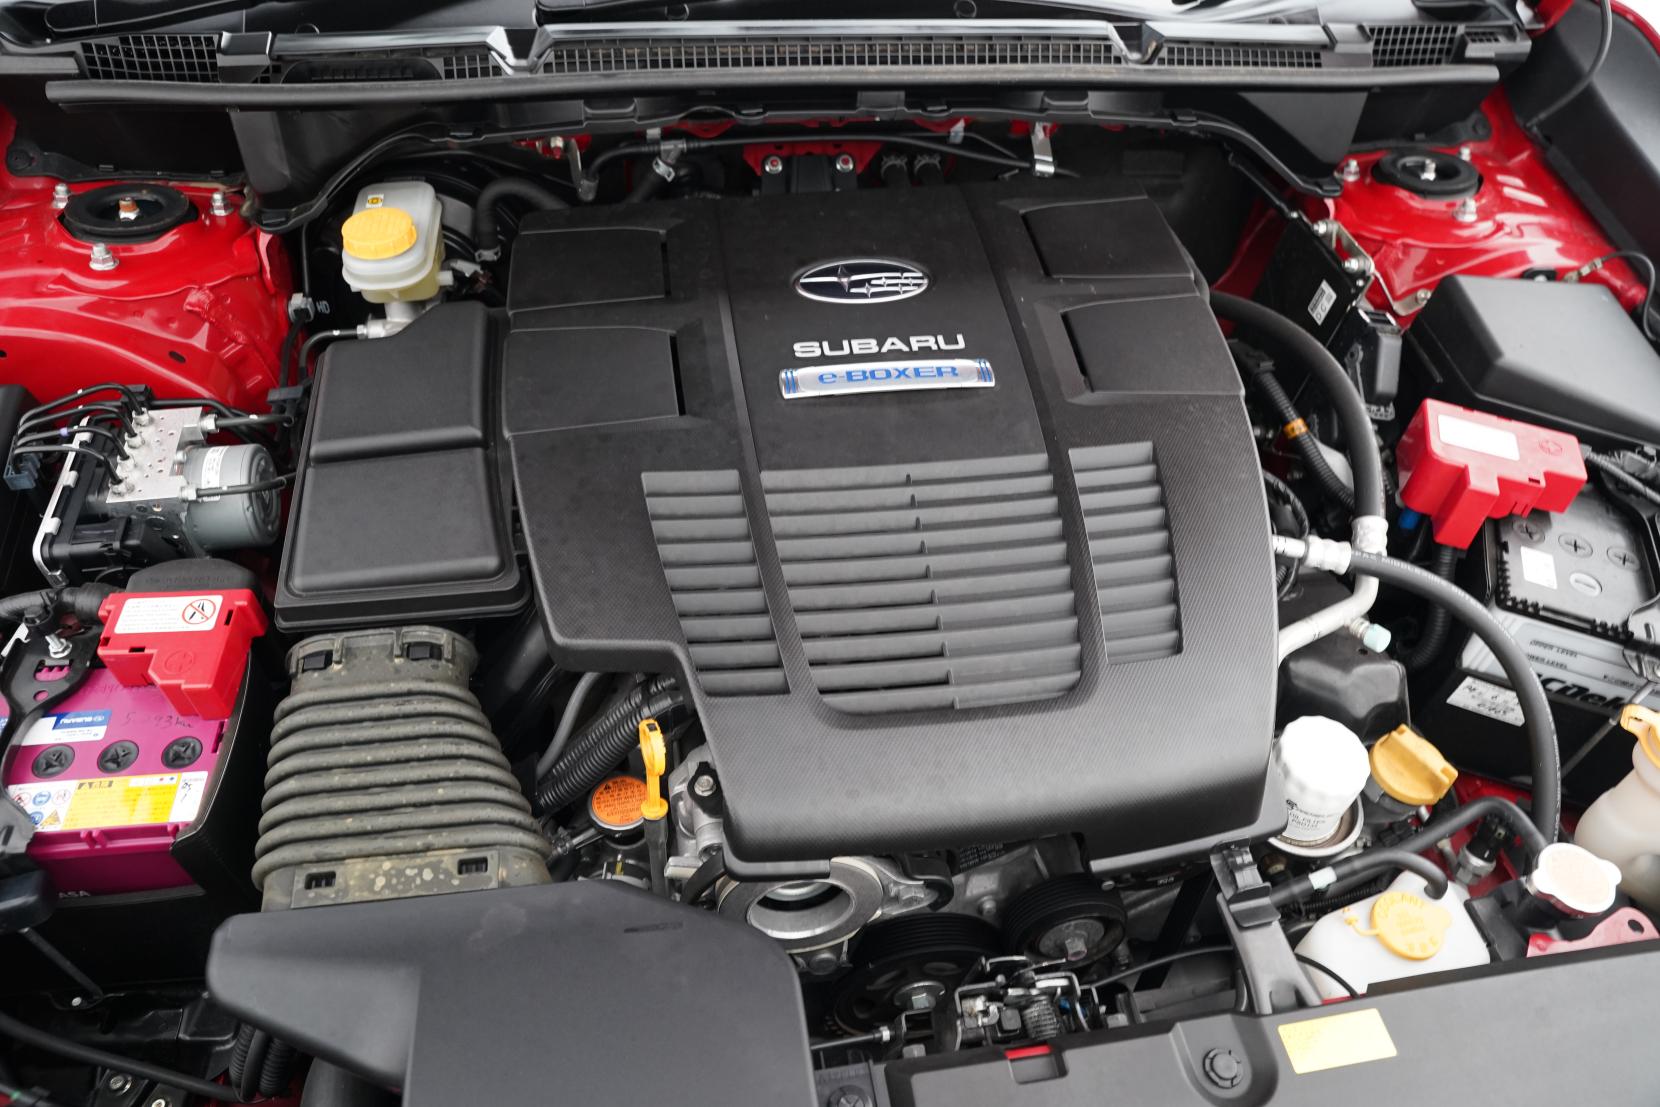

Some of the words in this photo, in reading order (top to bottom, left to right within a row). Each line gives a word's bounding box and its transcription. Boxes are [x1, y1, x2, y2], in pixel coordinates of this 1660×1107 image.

[793, 333, 966, 358] SUBARU
[818, 366, 959, 384] e-BOXER
[1538, 673, 1626, 708] CDel
